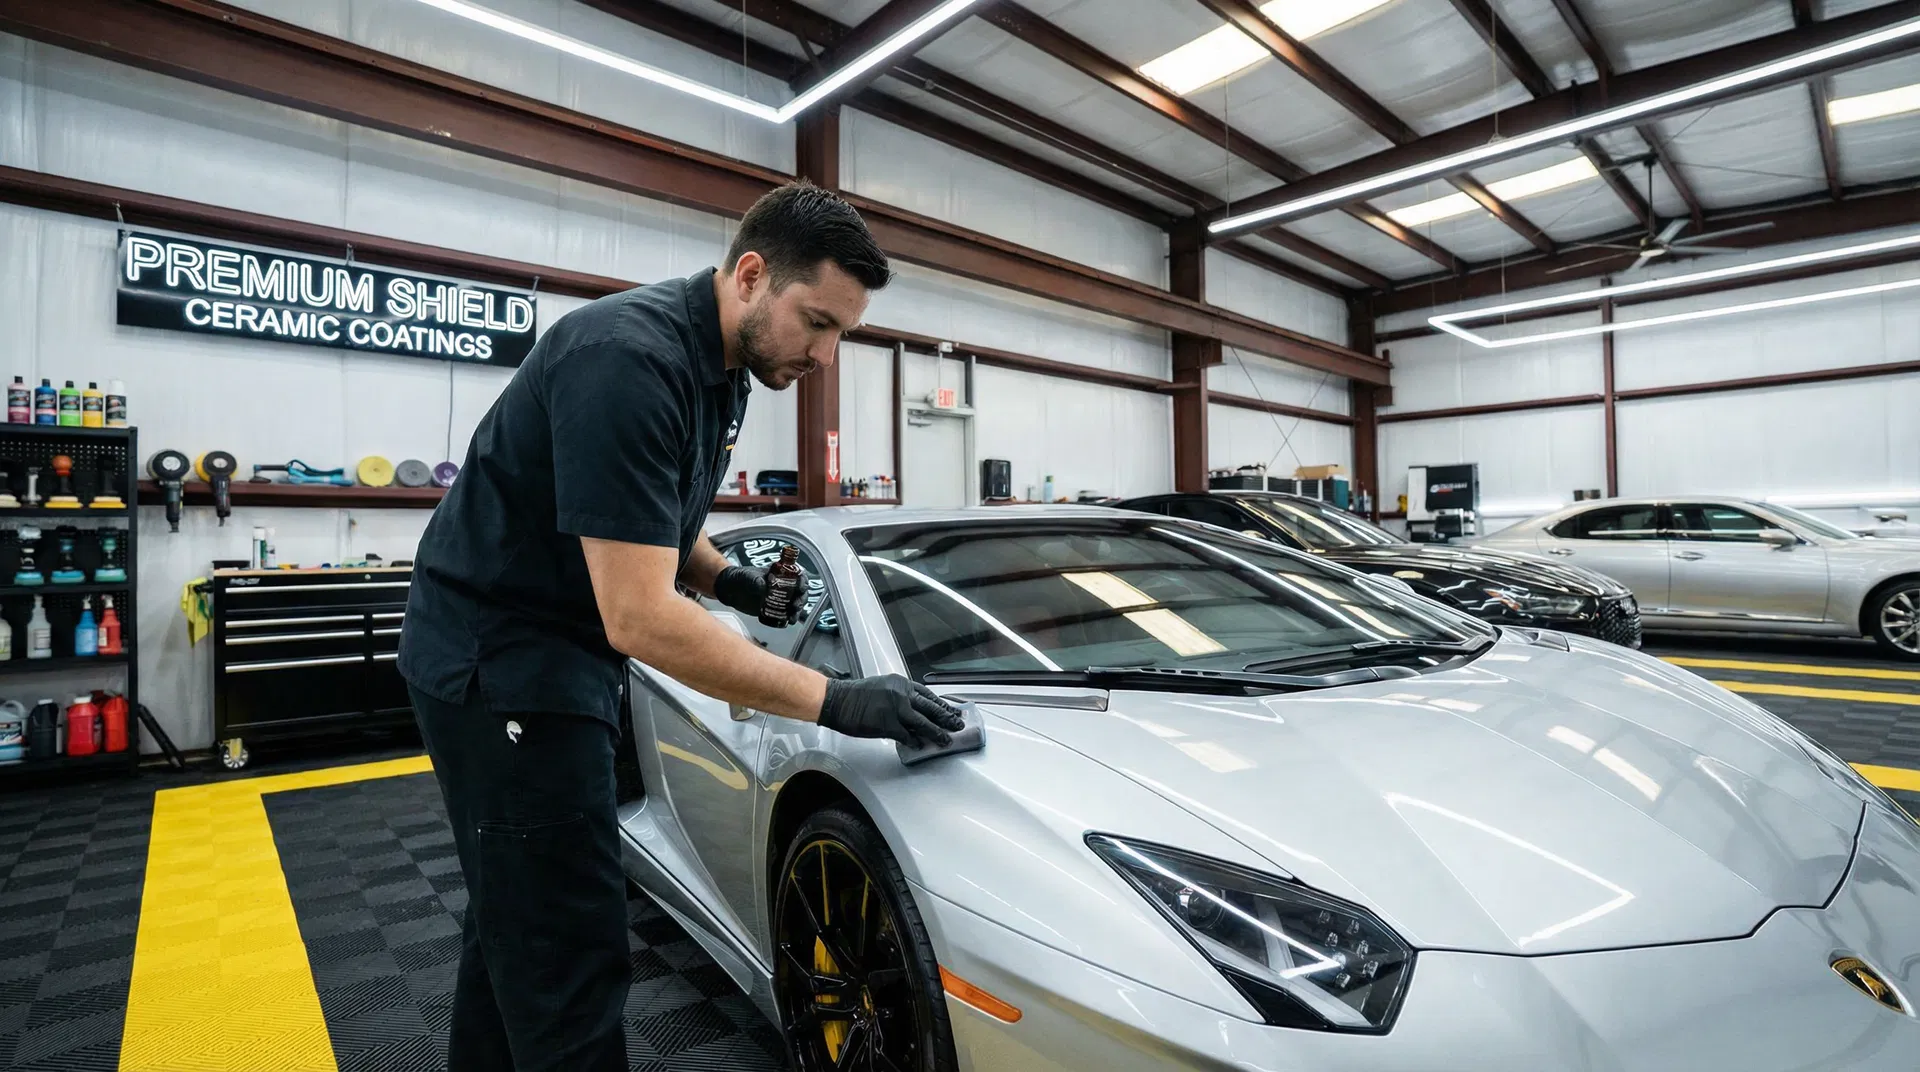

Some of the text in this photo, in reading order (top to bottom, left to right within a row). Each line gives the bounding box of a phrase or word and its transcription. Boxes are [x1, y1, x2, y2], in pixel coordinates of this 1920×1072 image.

[127, 237, 534, 333] PREMIUM SHIELD
[186, 298, 492, 359] CERAMIC COATINGS
[938, 388, 955, 407] EXIT
